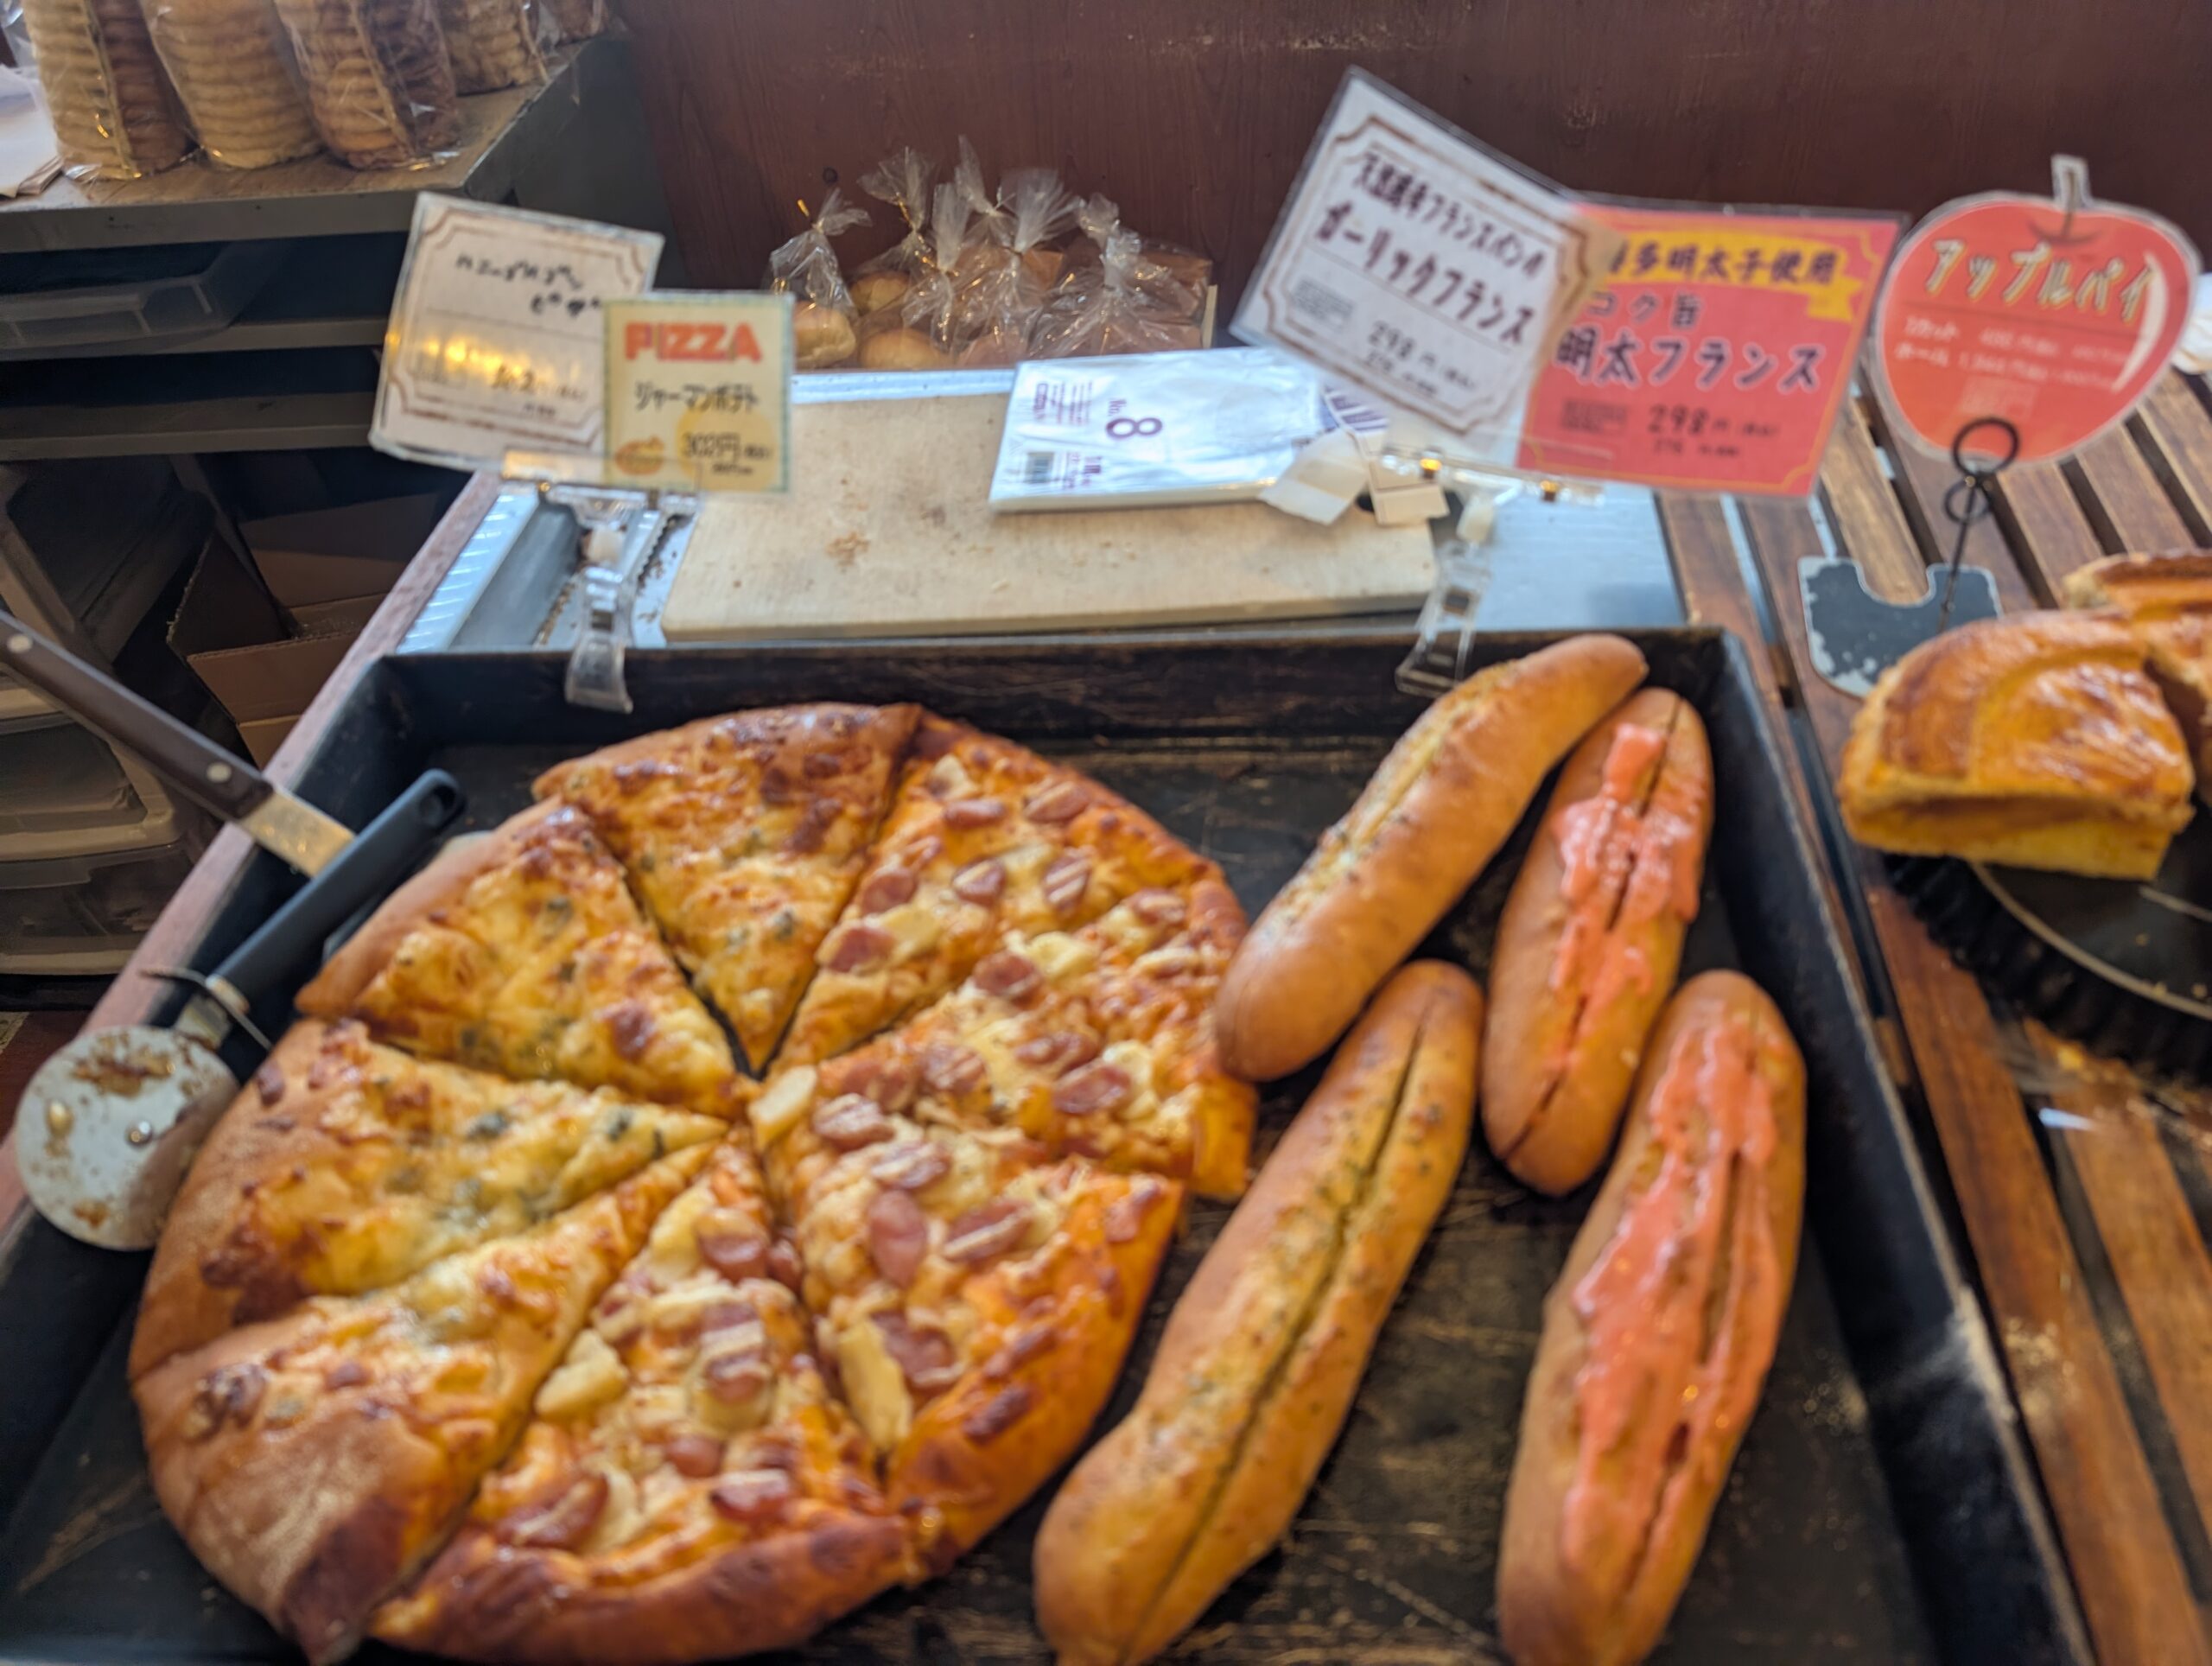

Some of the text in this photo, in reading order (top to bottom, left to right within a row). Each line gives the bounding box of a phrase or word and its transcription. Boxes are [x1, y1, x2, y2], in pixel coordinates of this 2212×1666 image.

[1315, 201, 1535, 346] ガーリックフランス
[1925, 238, 2157, 325] アップルパイ
[624, 321, 763, 363] PIZZA
[1556, 326, 1820, 391] 明太フランス
